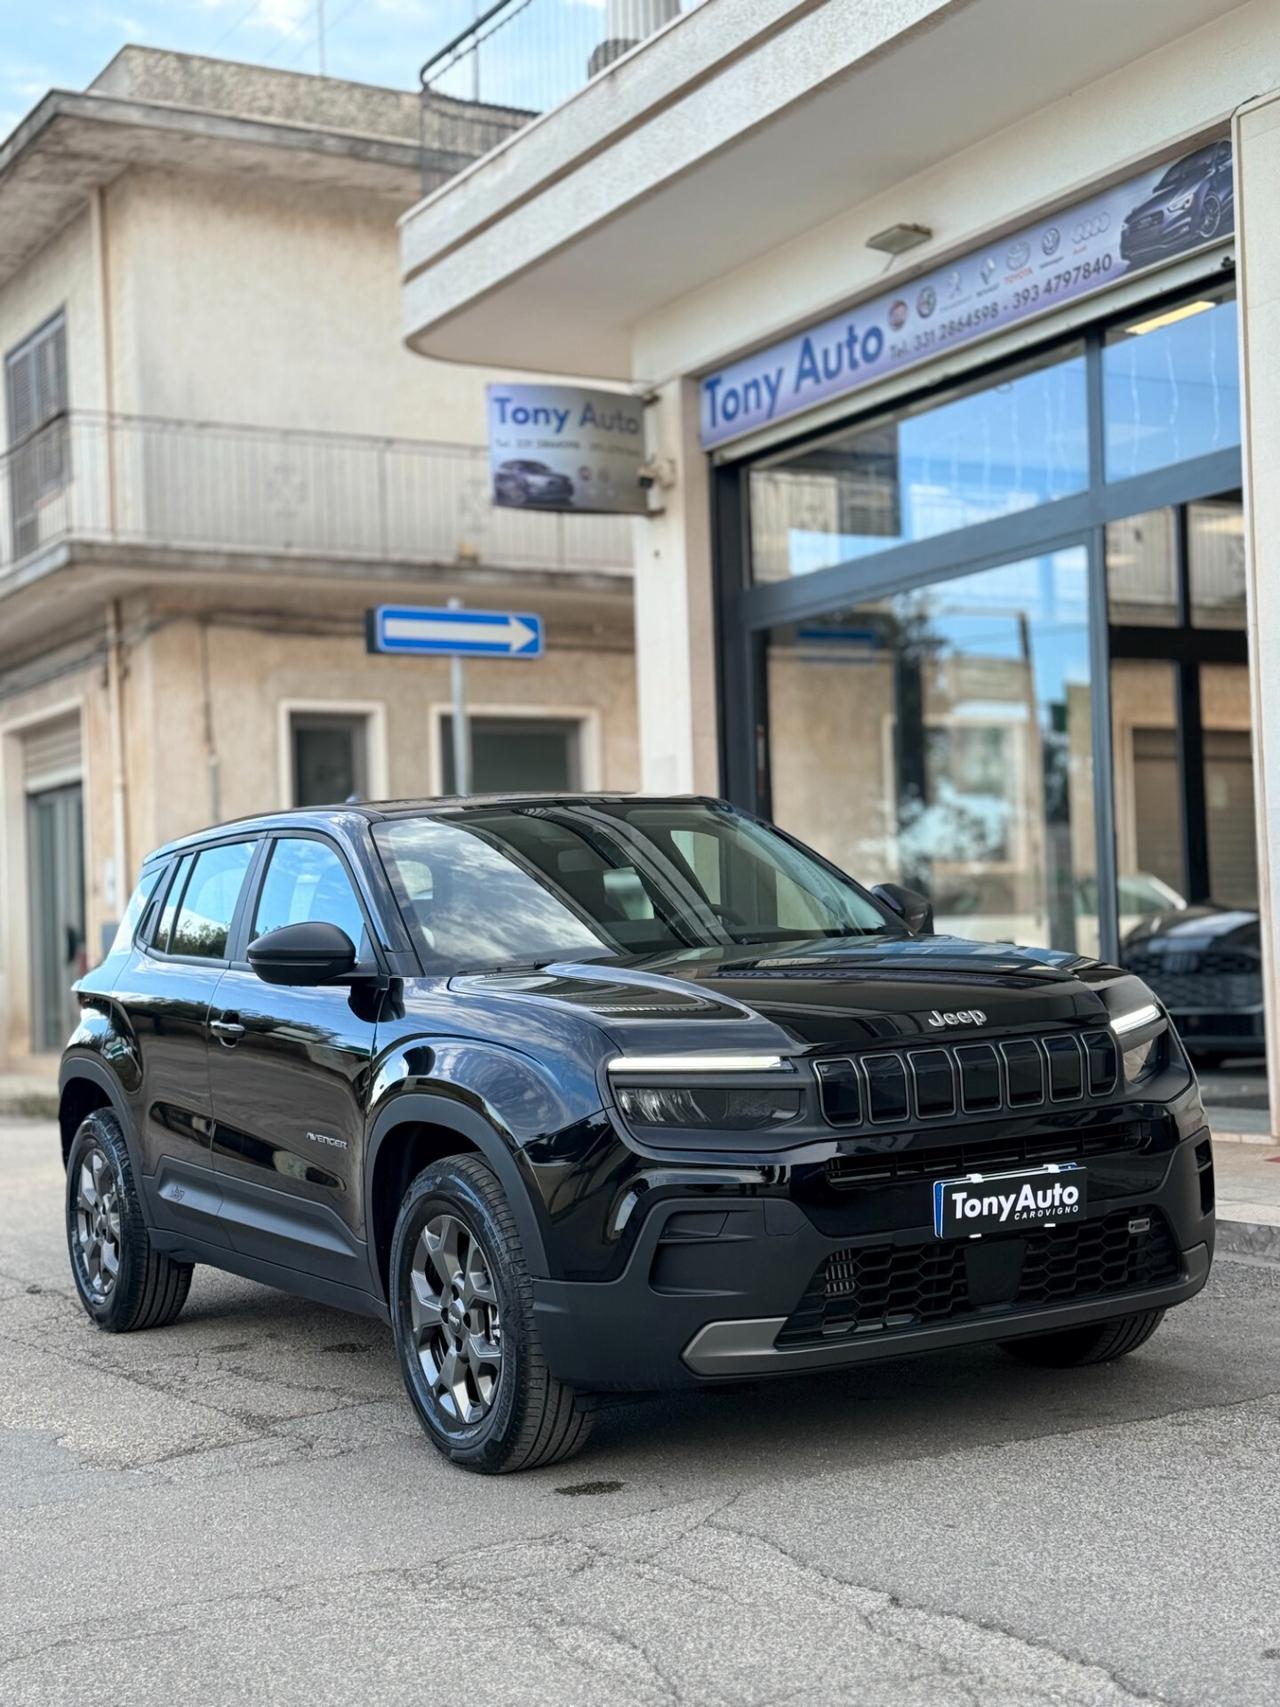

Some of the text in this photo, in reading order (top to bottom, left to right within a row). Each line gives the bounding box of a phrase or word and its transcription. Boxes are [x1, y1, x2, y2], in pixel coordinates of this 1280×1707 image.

[1012, 285, 1040, 309] 393
[1043, 253, 1112, 294] 4797840
[704, 325, 884, 428] Tony Auto
[493, 397, 640, 435] Tony Auto
[928, 1010, 987, 1027] Jeep
[306, 1131, 347, 1150] AVENGER
[952, 1183, 1079, 1222] TonyAuto
[1014, 1205, 1079, 1220] CAROVIGNO
